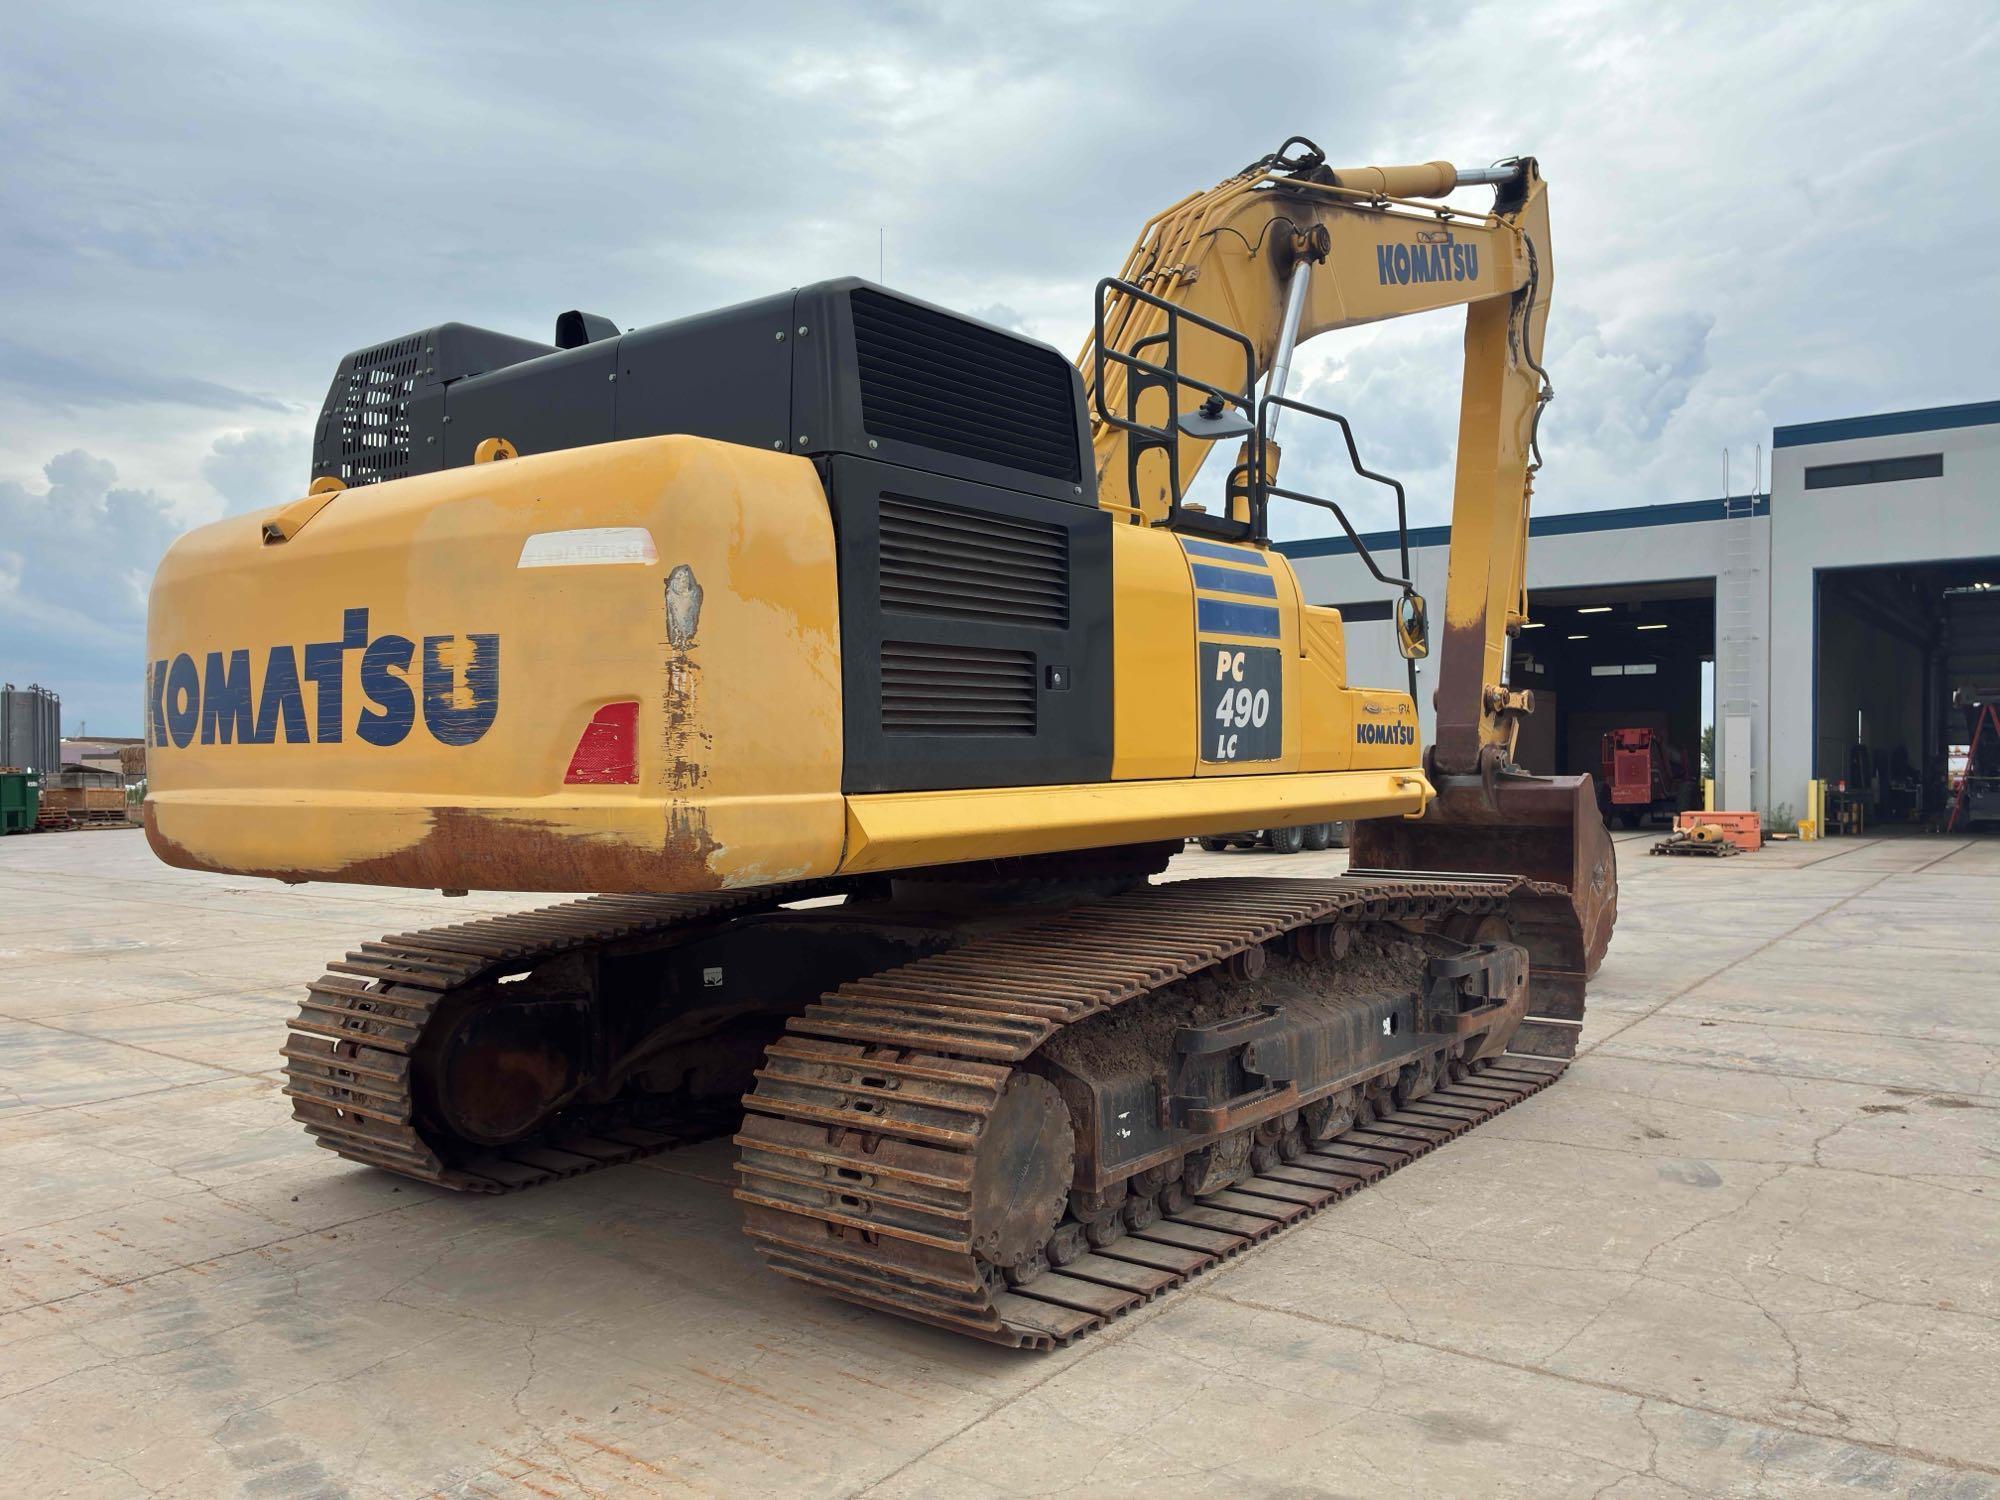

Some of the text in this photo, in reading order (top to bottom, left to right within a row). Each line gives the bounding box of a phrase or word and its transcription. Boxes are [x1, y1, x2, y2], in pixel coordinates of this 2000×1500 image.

[1376, 232, 1479, 285] KOMATSU
[147, 607, 500, 749] KOMATSU
[1216, 651, 1245, 682] PC
[1215, 687, 1270, 728] 490
[1216, 734, 1238, 759] LC
[1356, 719, 1415, 745] KOMATSU
